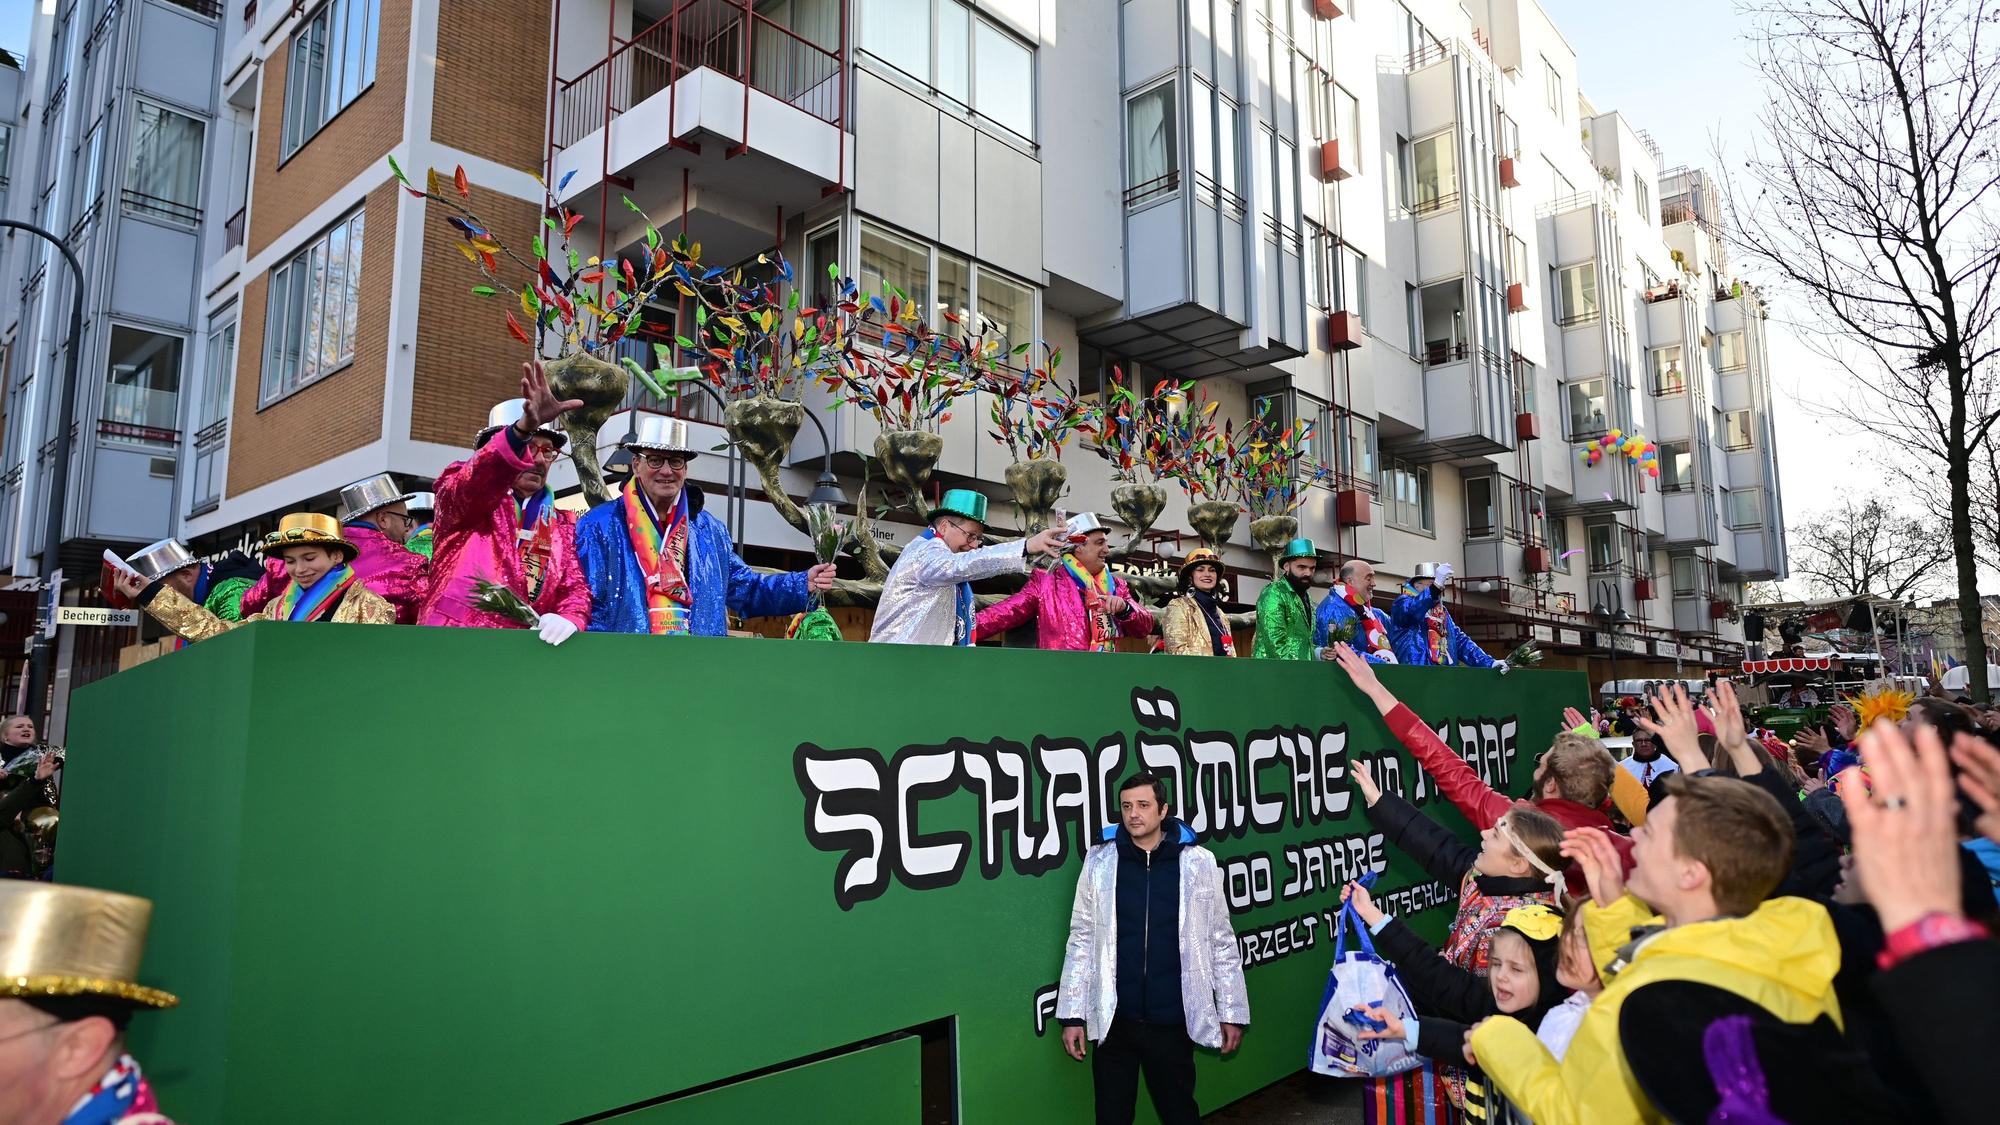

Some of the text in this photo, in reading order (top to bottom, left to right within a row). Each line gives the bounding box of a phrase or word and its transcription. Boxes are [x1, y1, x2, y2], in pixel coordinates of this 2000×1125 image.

[868, 527, 895, 541] ölner
[63, 610, 131, 624] Bechergasse
[1415, 720, 1517, 801] AAF
[1217, 833, 1388, 909] 00 JAHRE
[1240, 916, 1318, 966] RZELT
